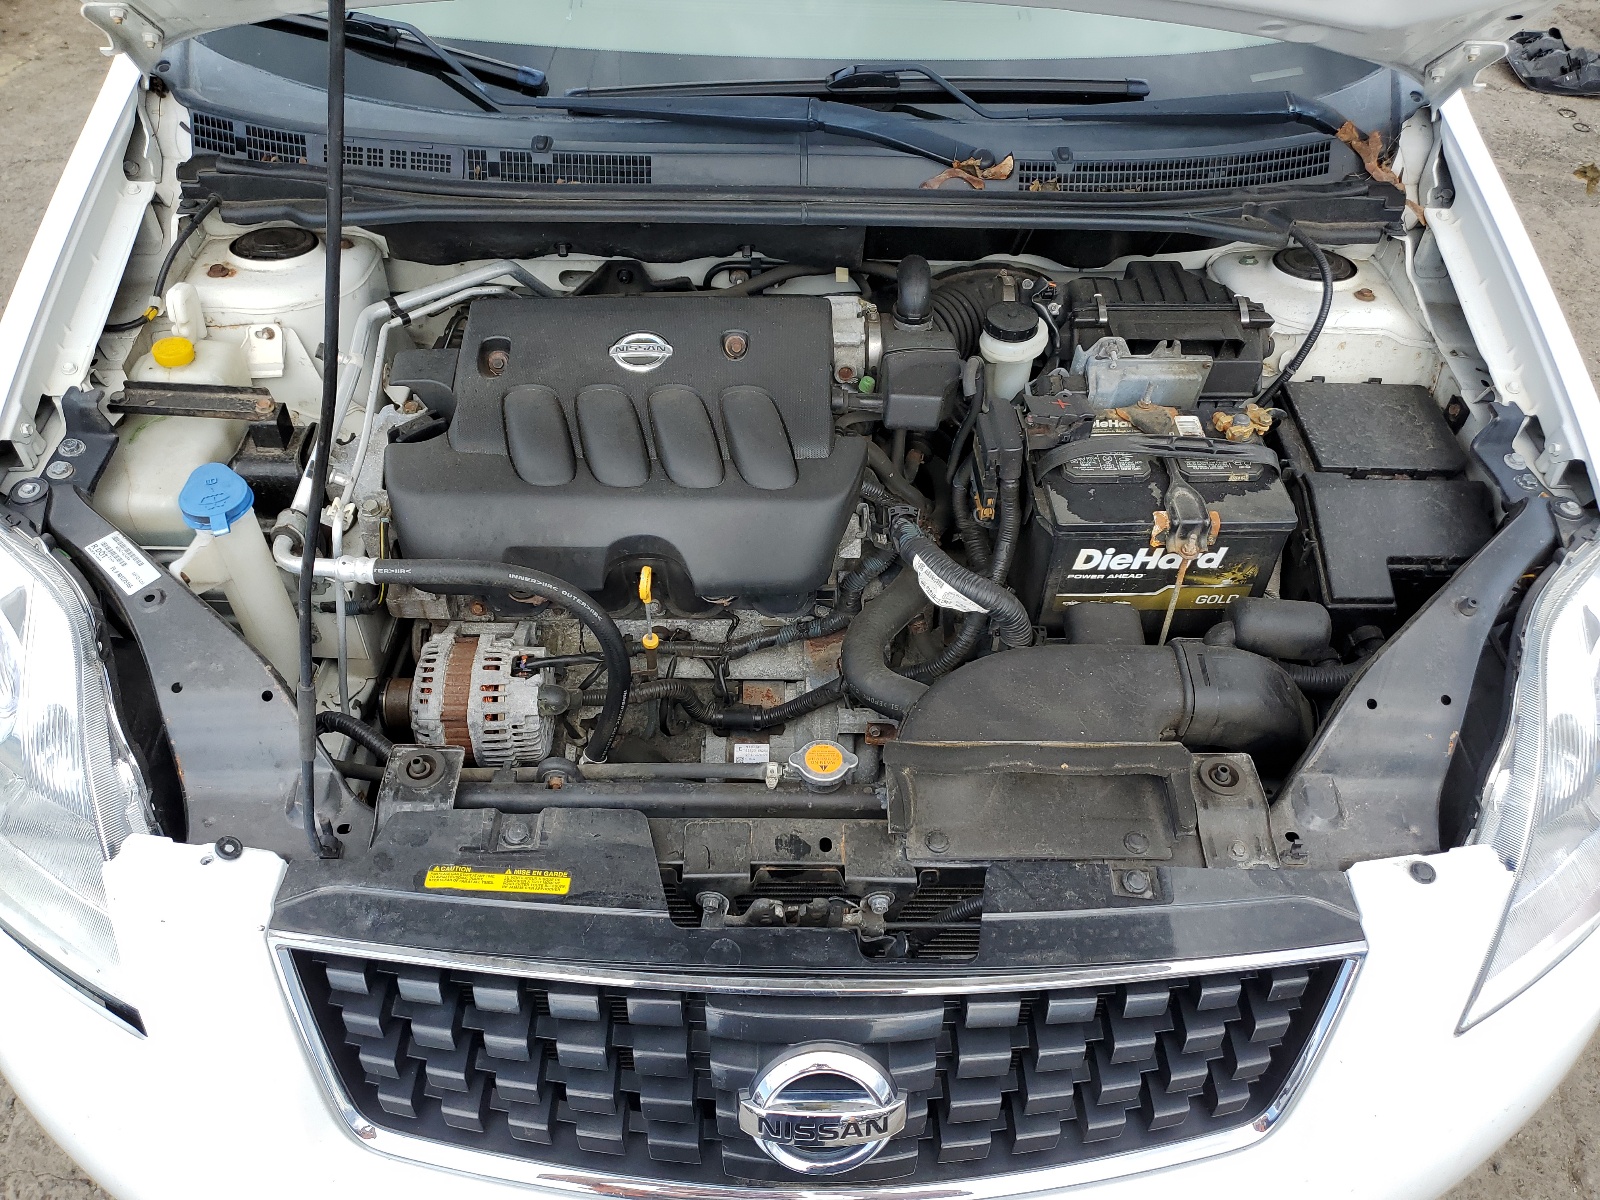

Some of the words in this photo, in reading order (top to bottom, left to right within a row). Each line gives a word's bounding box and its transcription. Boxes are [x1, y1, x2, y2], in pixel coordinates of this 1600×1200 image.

[1072, 546, 1229, 570] DieHad
[440, 865, 472, 873] CAUTION
[513, 868, 530, 876] MISE
[543, 870, 569, 878] GARDE
[757, 1116, 889, 1142] NISSAN
